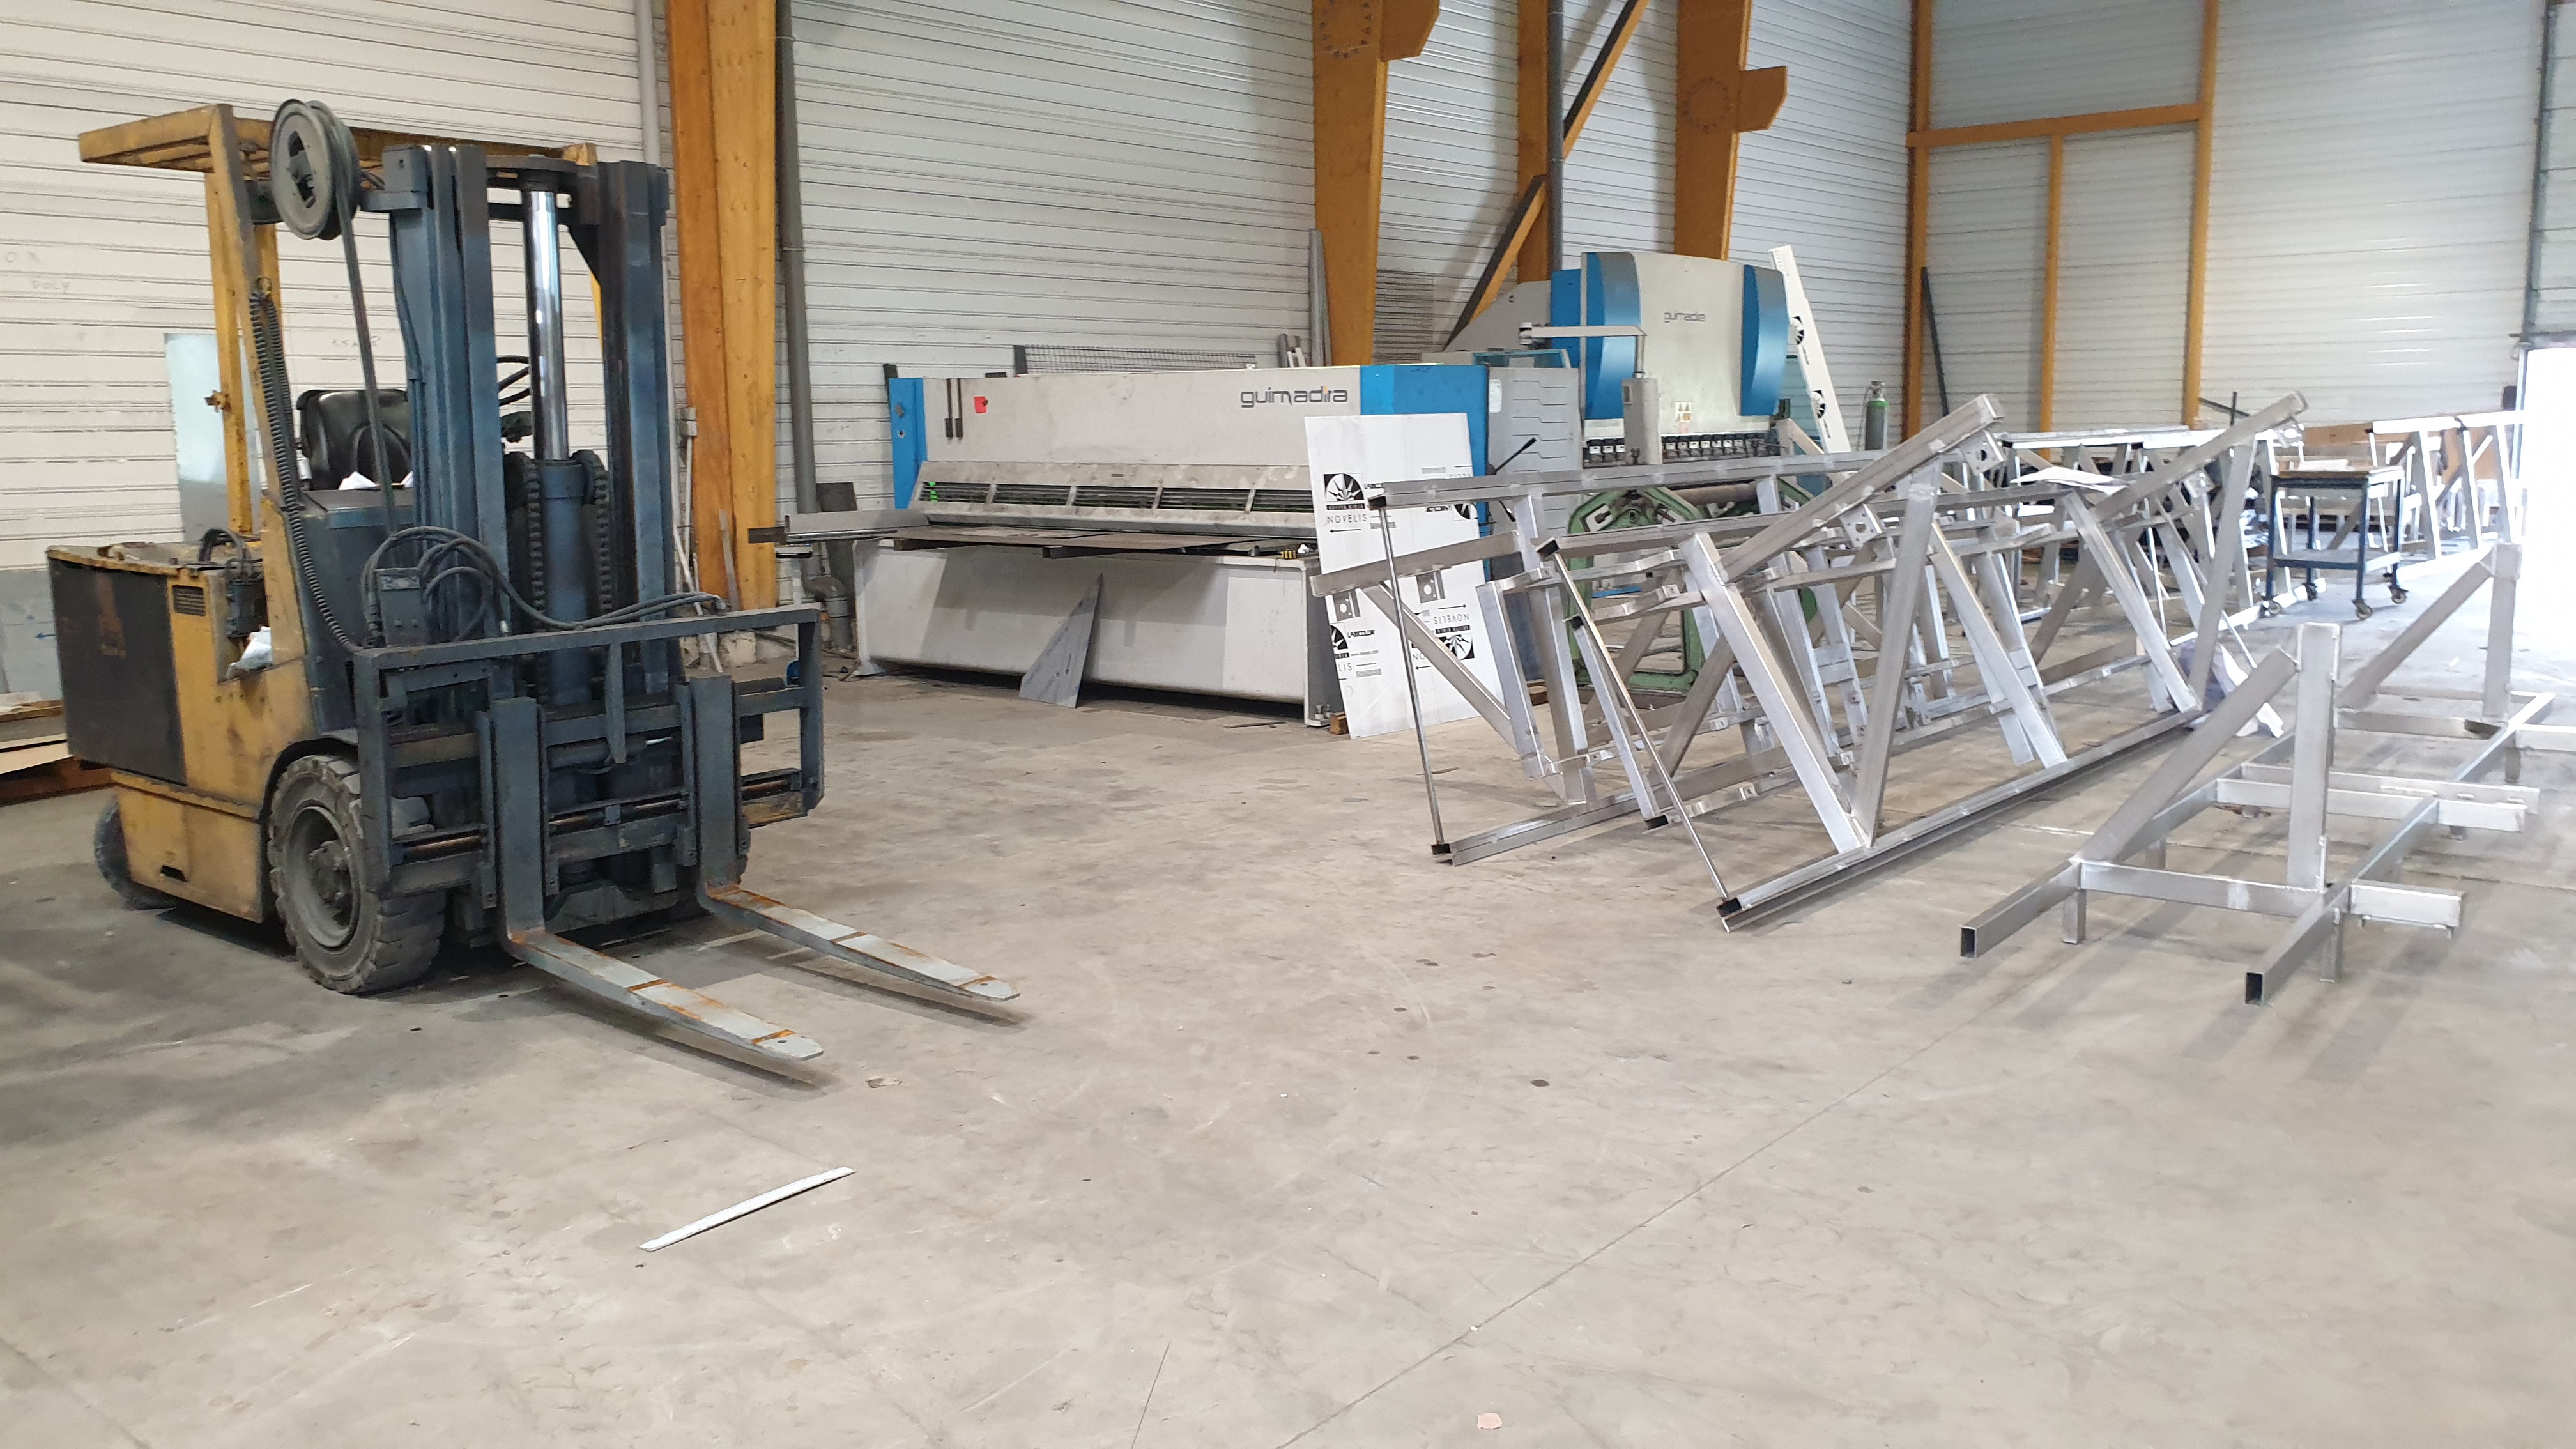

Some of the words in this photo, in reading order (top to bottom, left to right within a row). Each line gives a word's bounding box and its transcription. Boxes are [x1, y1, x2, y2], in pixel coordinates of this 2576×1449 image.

[1241, 385, 1347, 408] guimadira
[1327, 514, 1367, 523] NOVELIS
[1433, 613, 1470, 624] NOVELIS
